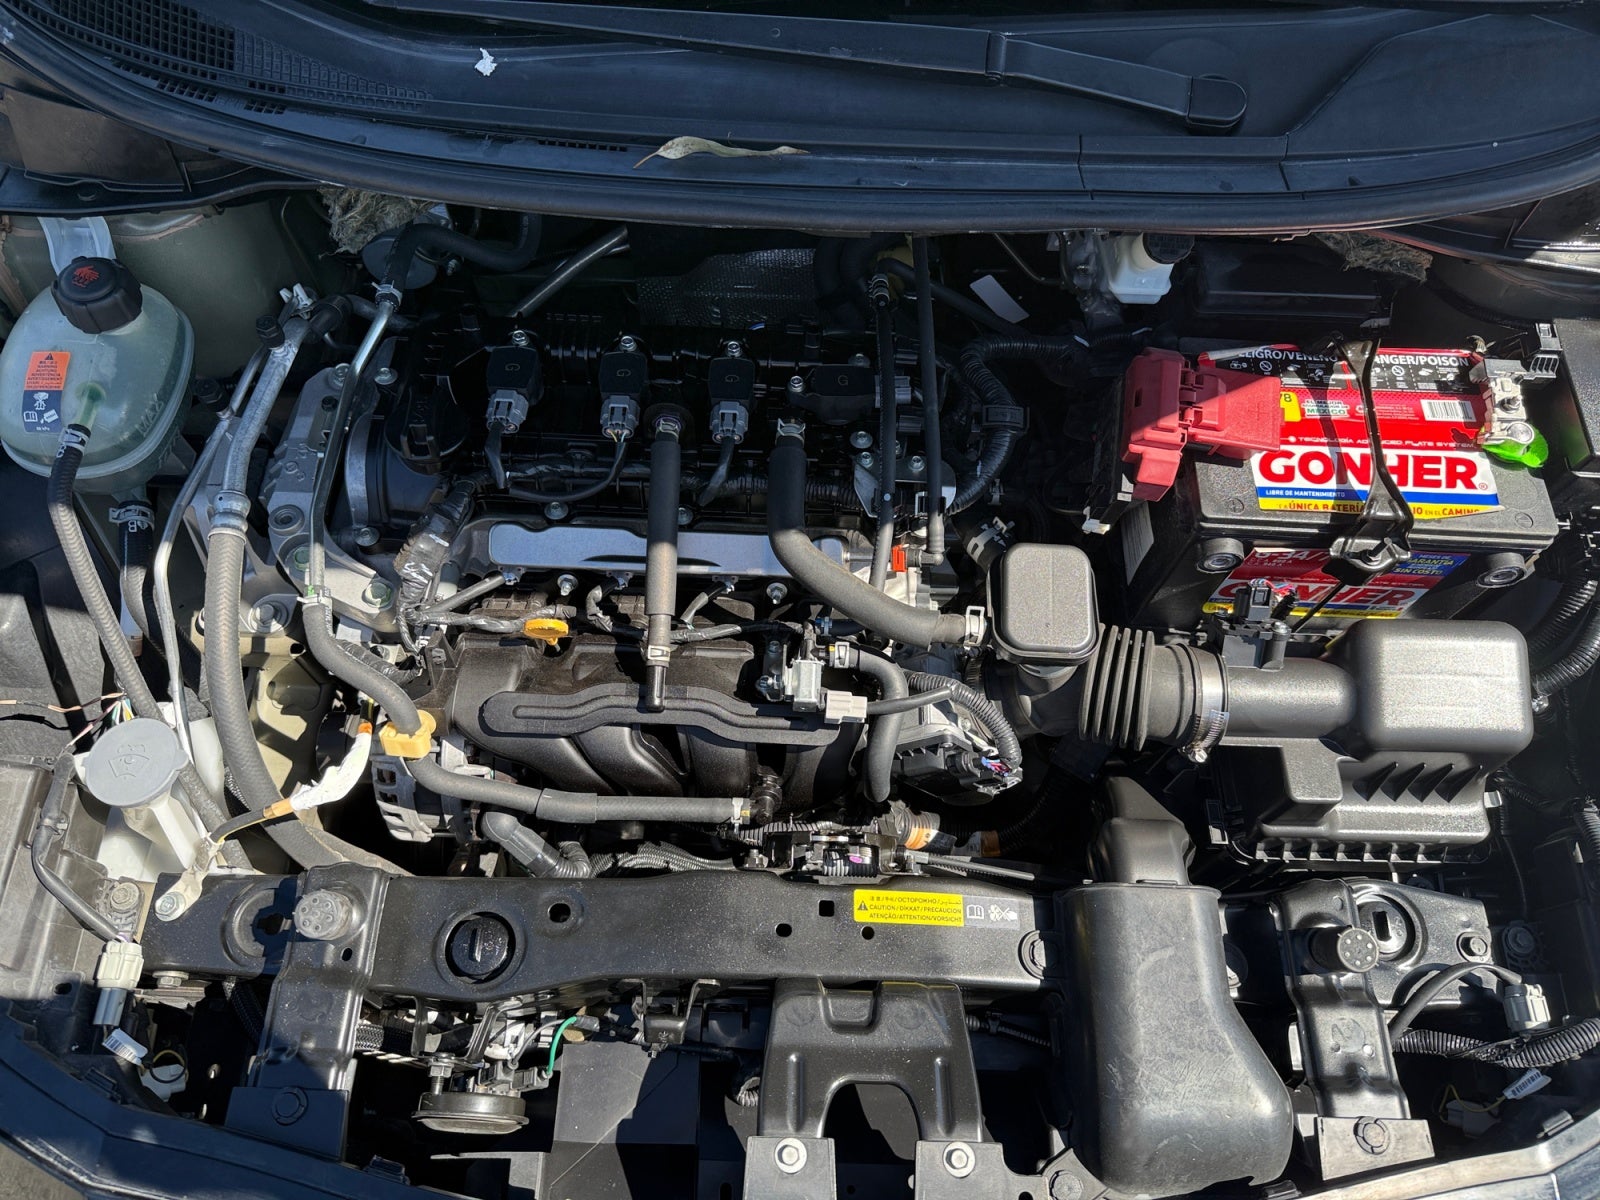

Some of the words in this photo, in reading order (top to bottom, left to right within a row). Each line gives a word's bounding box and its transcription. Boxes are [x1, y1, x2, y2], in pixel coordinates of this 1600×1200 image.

[1374, 354, 1469, 366] ANGER/POISON
[1259, 449, 1478, 490] GONHER
[1288, 500, 1319, 510] ÚNICA
